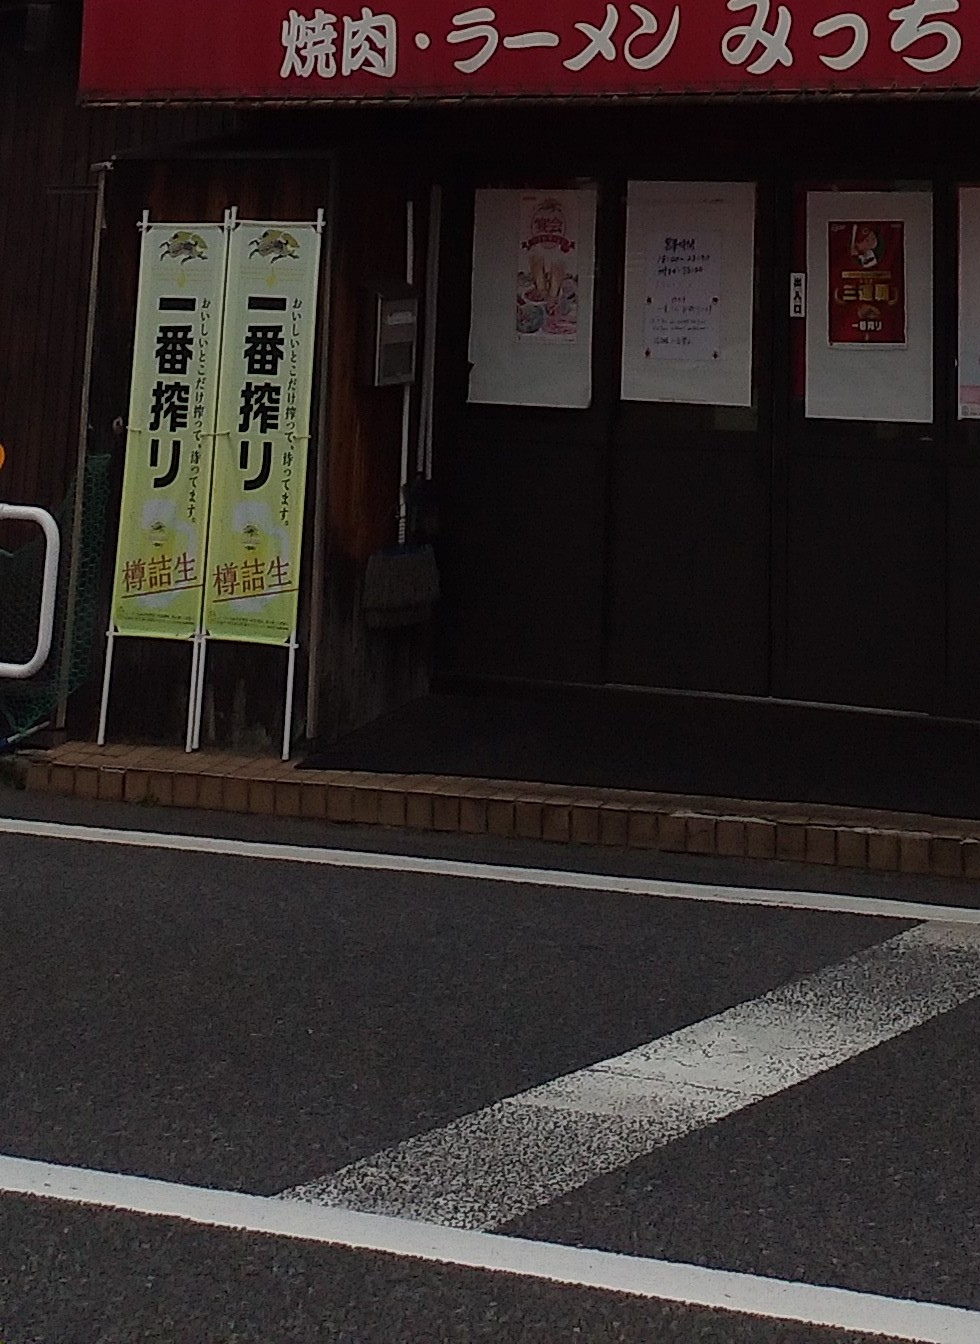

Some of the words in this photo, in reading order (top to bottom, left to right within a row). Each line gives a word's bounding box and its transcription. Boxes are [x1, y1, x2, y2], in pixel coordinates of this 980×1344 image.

[281, 2, 680, 79] 焼肉・ラーメン
[149, 296, 197, 490] 一番搾り
[238, 296, 287, 492] 一番搾り
[122, 552, 199, 593] 樽詰生
[212, 556, 293, 597] 樽詰生
